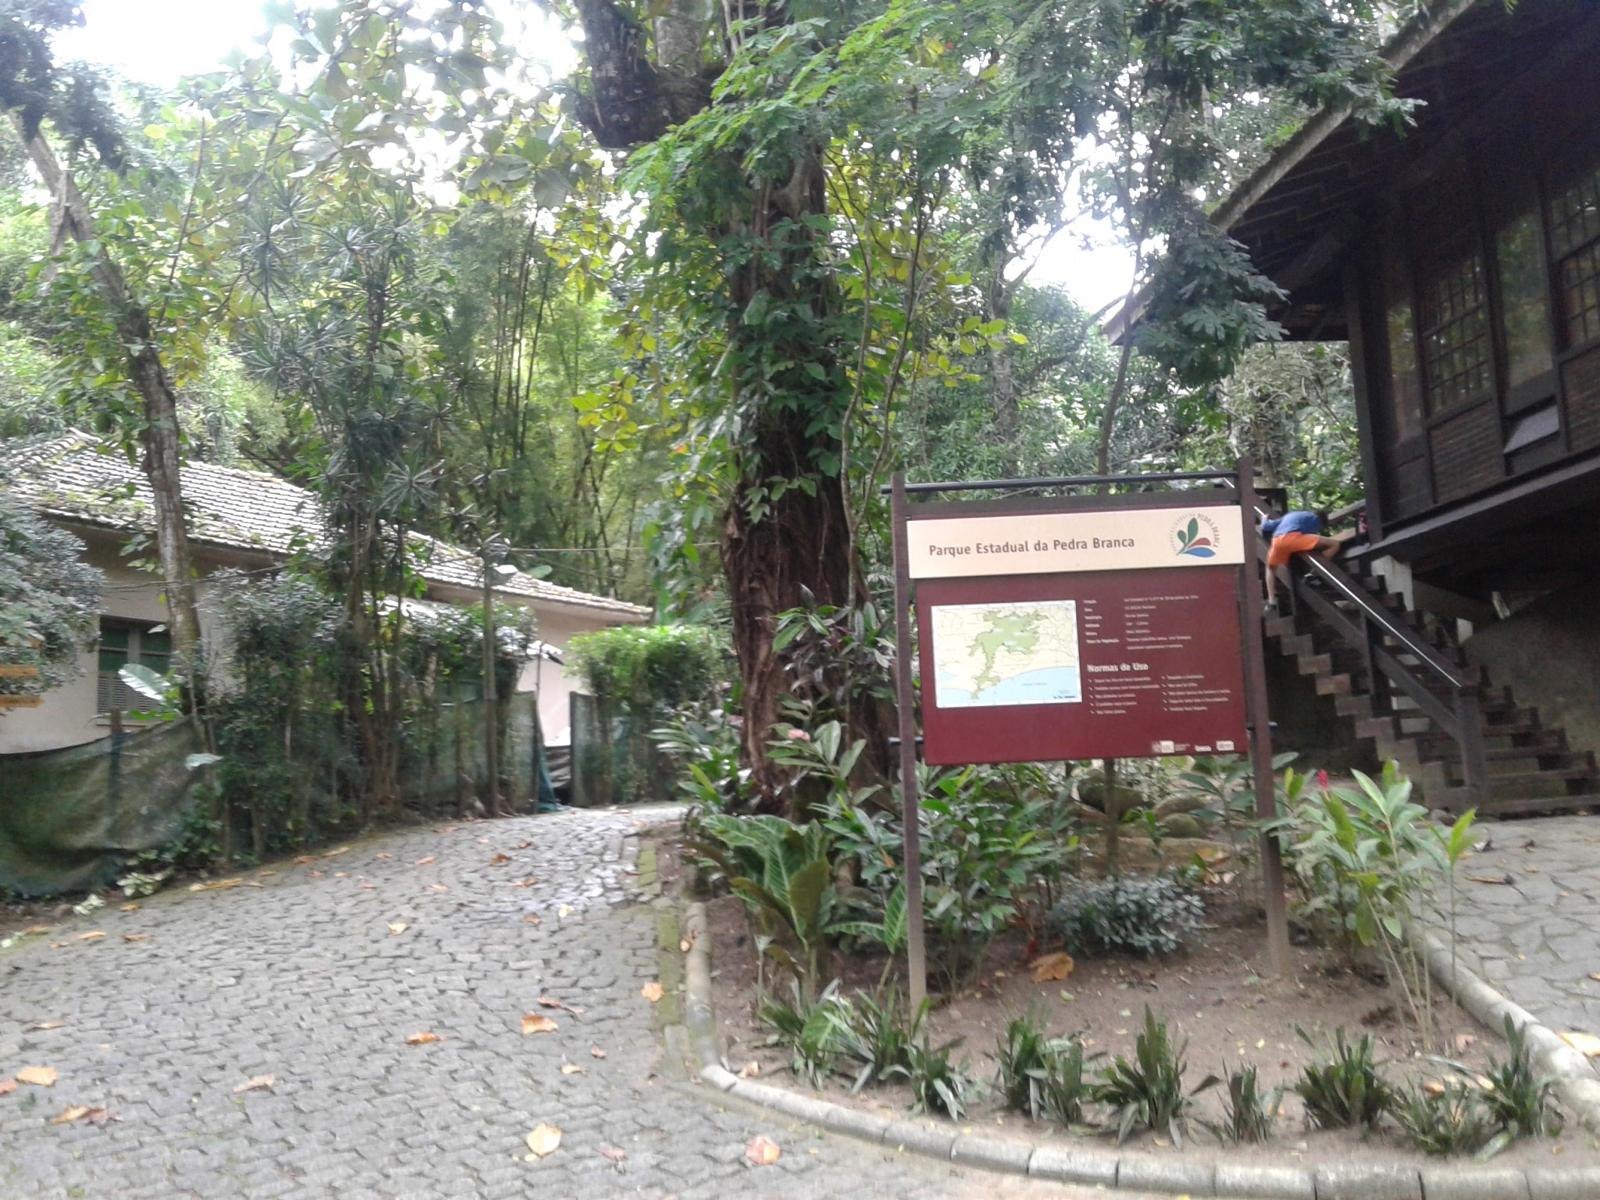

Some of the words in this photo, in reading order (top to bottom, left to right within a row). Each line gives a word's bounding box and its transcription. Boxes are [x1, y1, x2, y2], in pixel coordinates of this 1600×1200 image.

[929, 544, 971, 557] Parque
[976, 541, 1029, 554] Estadual
[1034, 539, 1049, 551] da
[1053, 538, 1088, 550] Pedra
[1092, 537, 1135, 549] Branca
[1087, 663, 1119, 673] Normas
[1120, 662, 1131, 671] de
[1132, 661, 1149, 671] Uso
